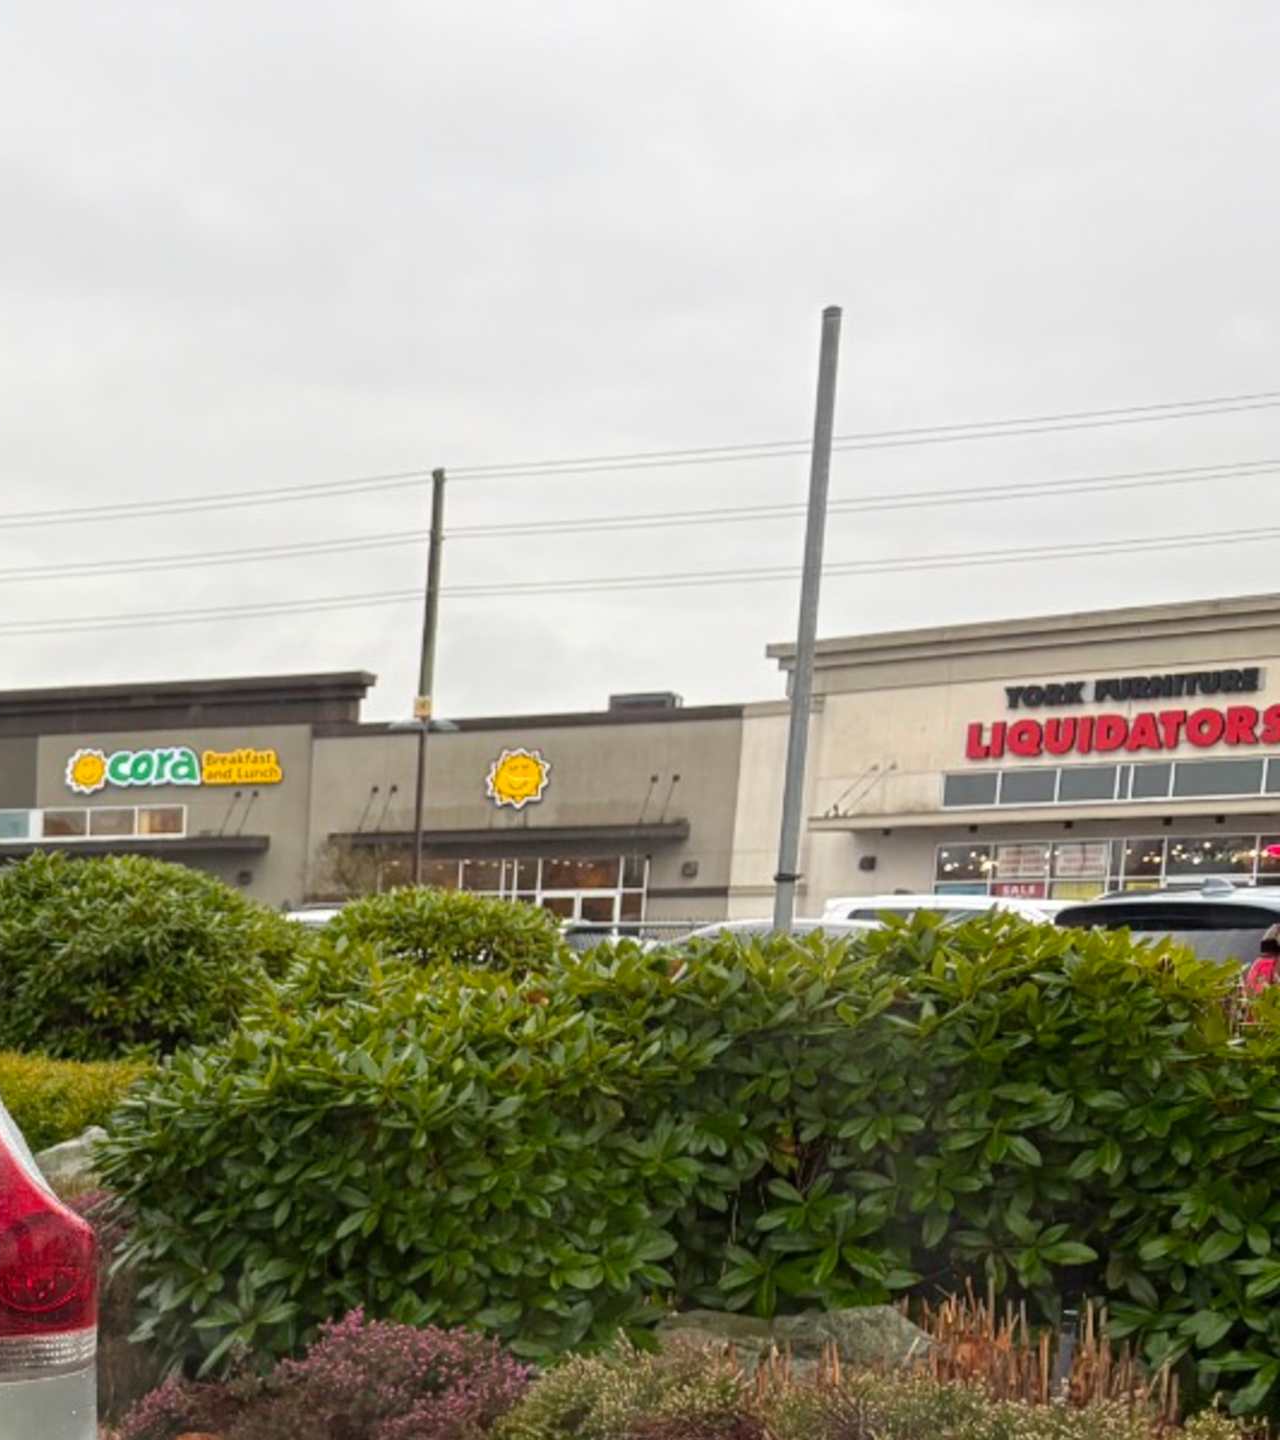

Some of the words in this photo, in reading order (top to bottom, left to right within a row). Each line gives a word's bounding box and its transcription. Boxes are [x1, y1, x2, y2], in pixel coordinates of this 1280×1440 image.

[1004, 681, 1087, 709] YORK
[1094, 667, 1261, 703] FURNITURE
[206, 768, 233, 780] and
[236, 766, 280, 779] Lunch
